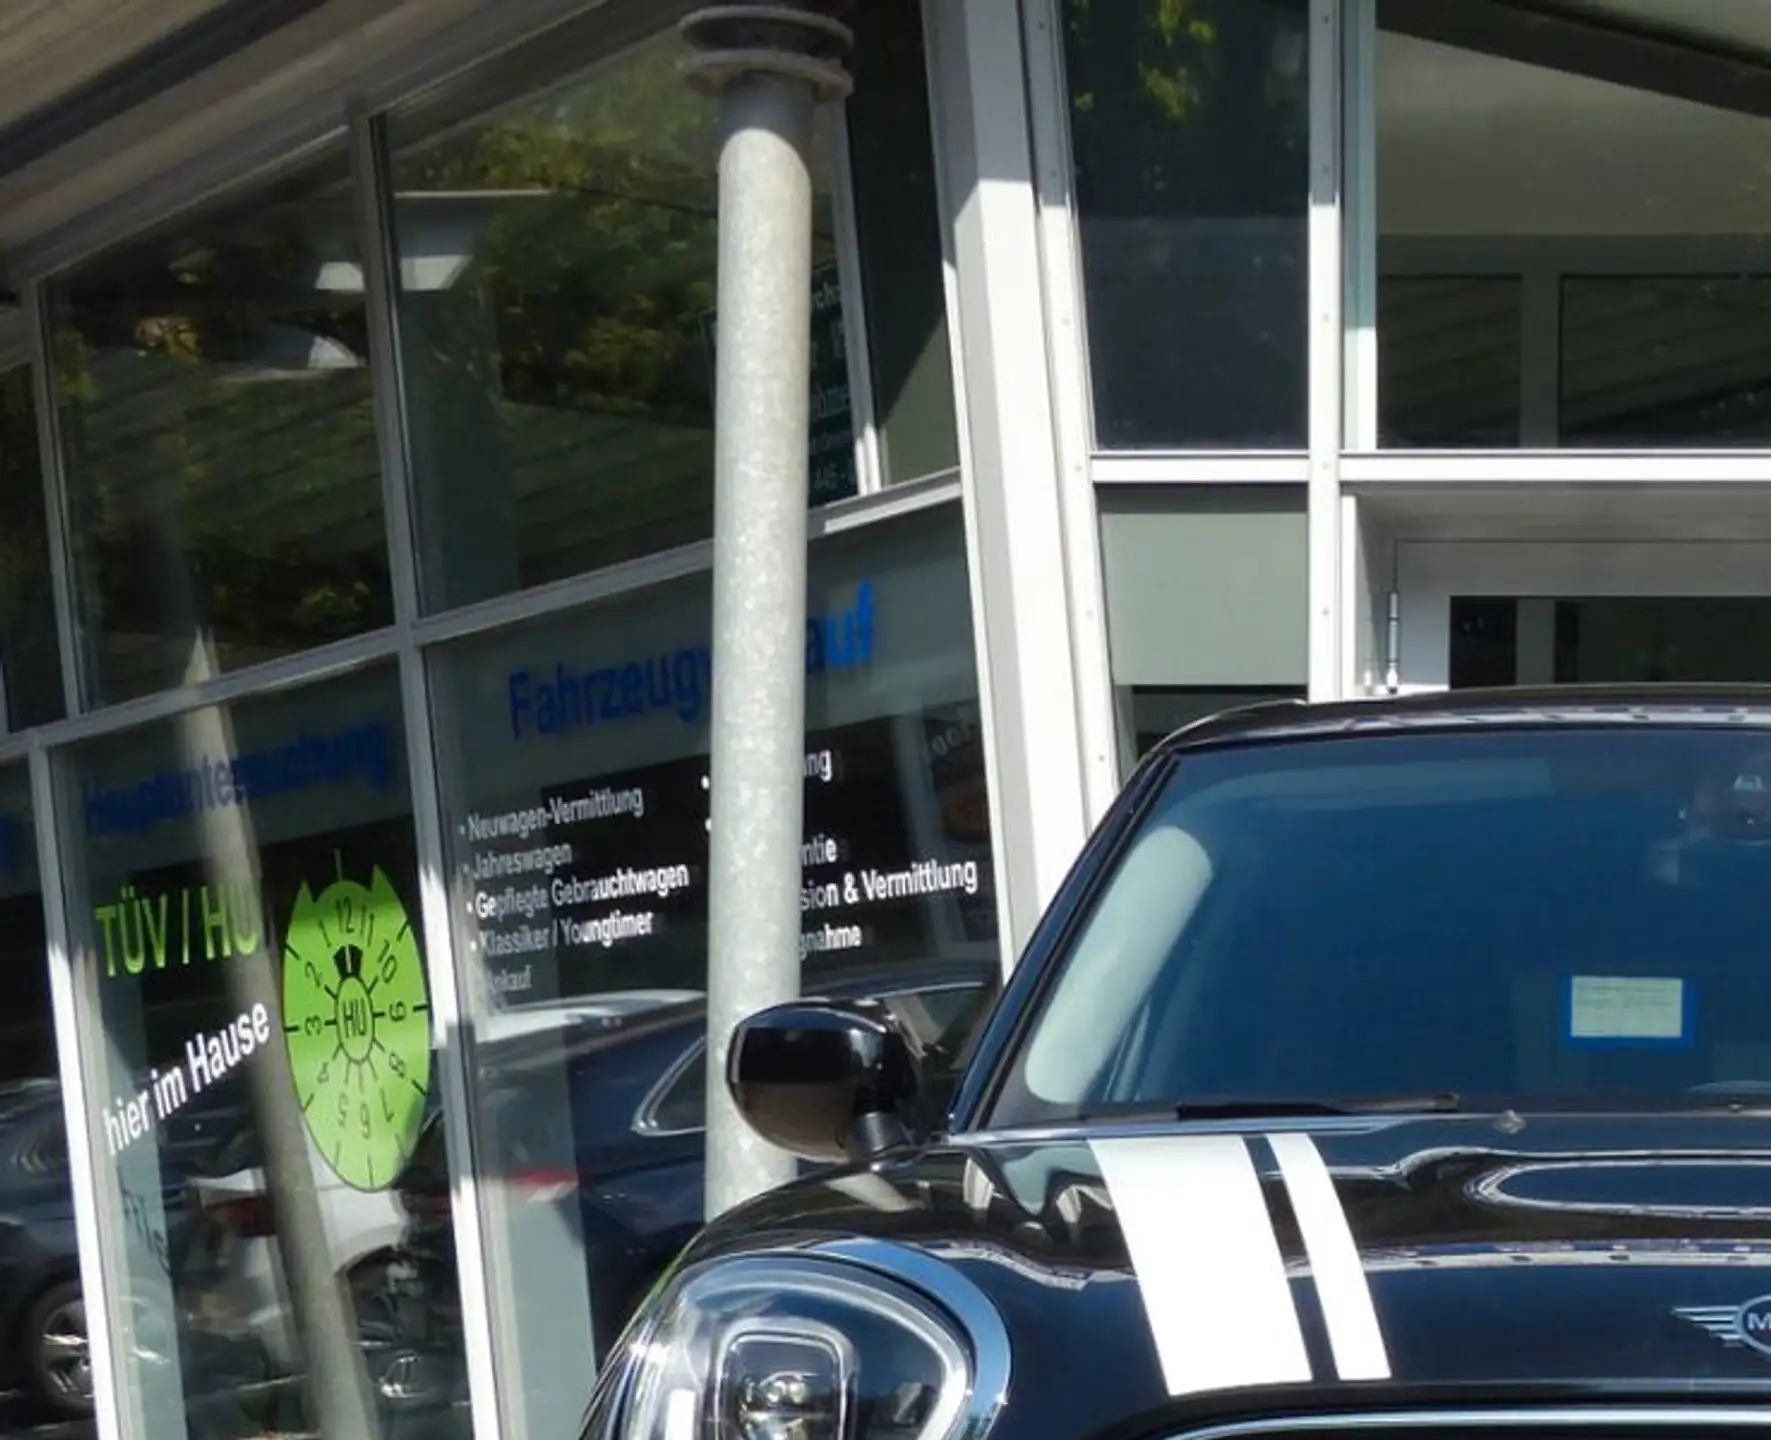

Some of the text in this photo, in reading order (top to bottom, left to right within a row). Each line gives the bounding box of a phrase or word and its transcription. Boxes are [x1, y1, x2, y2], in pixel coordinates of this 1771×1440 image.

[509, 578, 874, 741] Fahrzeugauf
[468, 787, 645, 841] Neuwagen-Vermittlung
[473, 843, 573, 880] Jahreswagen
[800, 832, 837, 866] ntie
[475, 863, 690, 920] Gepflegte Gebrauchtwagen
[800, 859, 977, 910] sion & Vermittlung
[94, 885, 169, 978] TÜV
[201, 883, 259, 961] HU
[480, 926, 549, 956] Klassiker
[560, 908, 654, 947] Youngtimer
[799, 922, 862, 961] gnahme
[342, 996, 369, 1040] HU
[102, 1002, 271, 1156] hier im Hause
